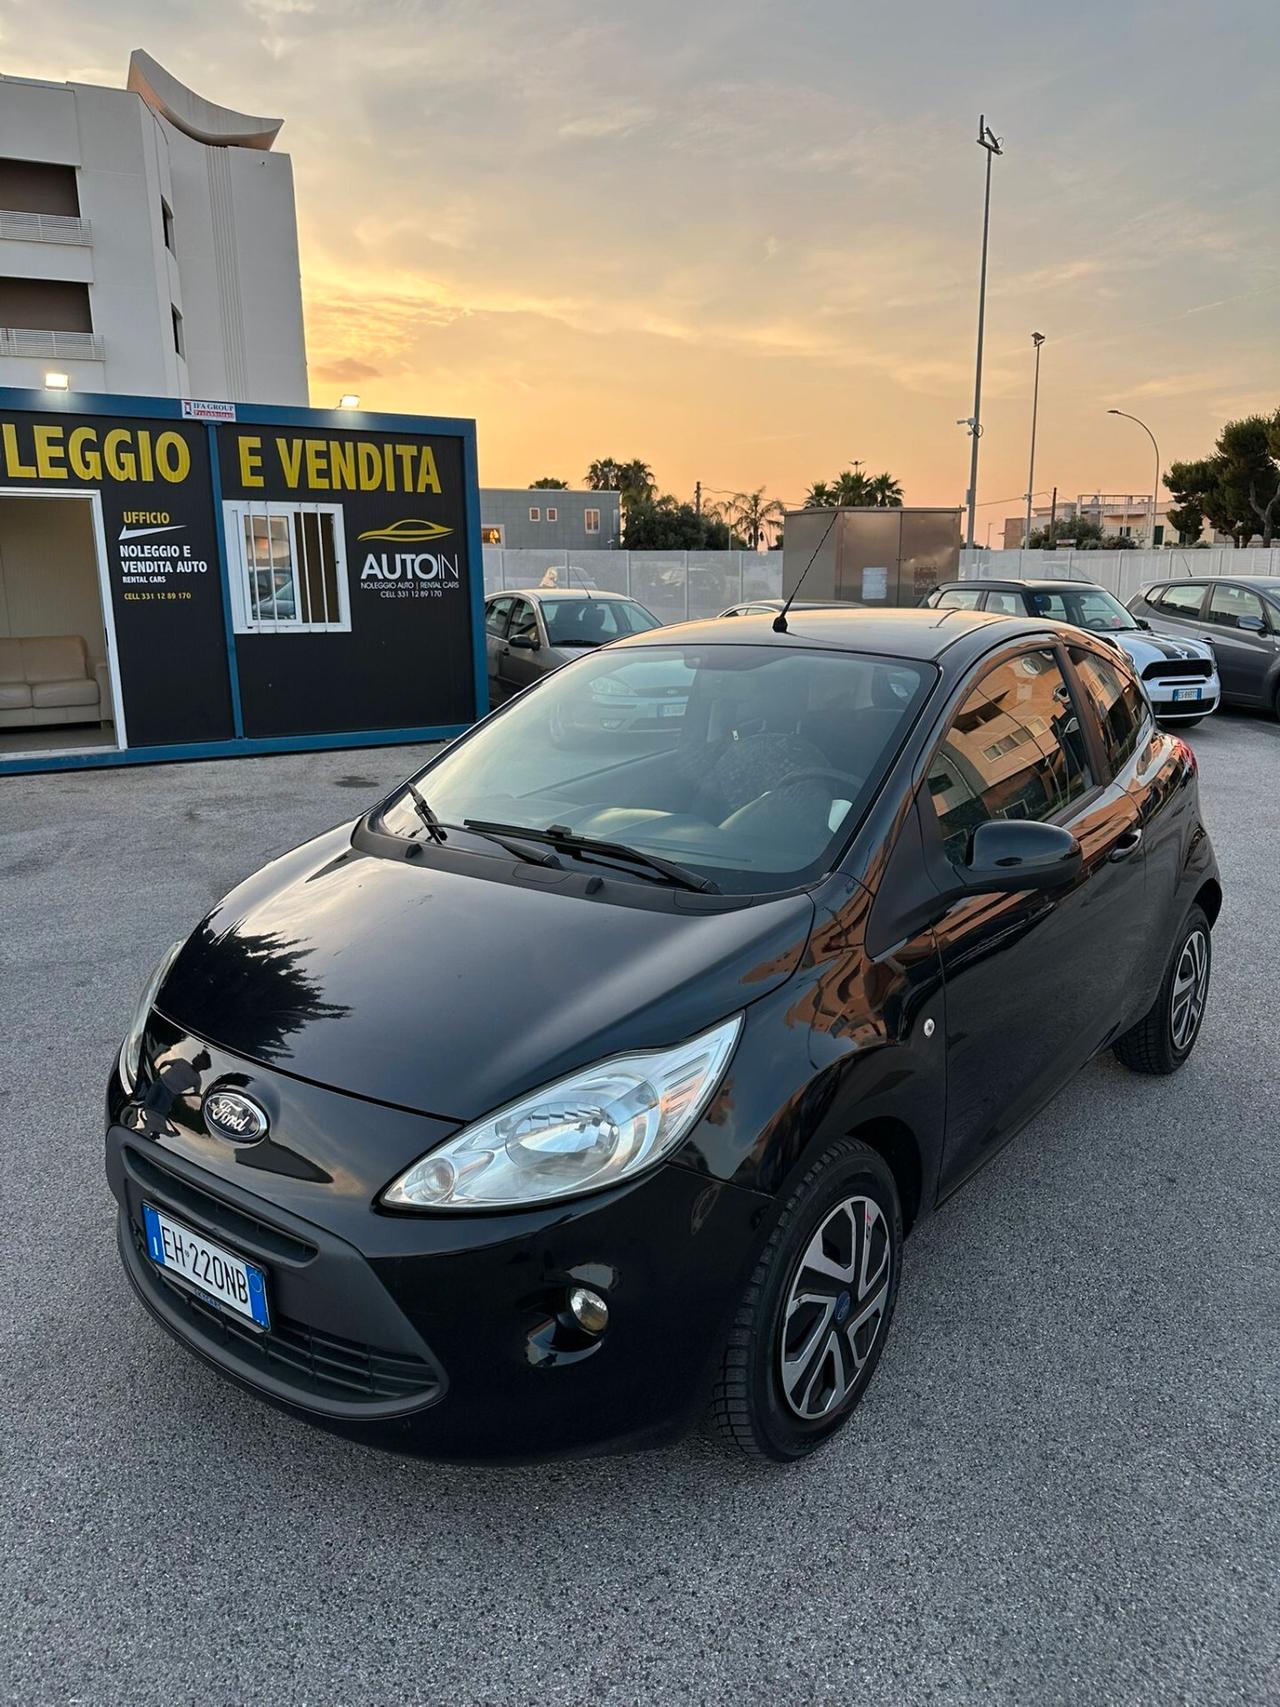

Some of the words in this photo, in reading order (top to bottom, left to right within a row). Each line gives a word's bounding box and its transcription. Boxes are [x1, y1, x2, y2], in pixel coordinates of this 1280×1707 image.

[2, 423, 191, 483] LEGGIO
[238, 436, 265, 487] E
[276, 438, 442, 494] VENDITA
[123, 511, 170, 524] UFFICIO
[119, 545, 180, 558] NOLEGGIO
[182, 545, 192, 558] E
[121, 561, 174, 574] VENDITA
[176, 561, 208, 574] AUTO
[122, 575, 148, 584] RENTAL
[149, 575, 167, 584] CARS
[360, 581, 396, 589] NOLEGGIO
[420, 581, 441, 589] RENTAL
[442, 581, 459, 589] CARS
[124, 592, 141, 600] CELL
[141, 592, 155, 600] 331
[157, 592, 166, 600] 12
[178, 592, 192, 600] 170
[380, 590, 396, 598] CELL
[397, 590, 409, 598] 331
[411, 590, 420, 598] 12
[420, 590, 429, 598] 89
[430, 590, 442, 598] 170
[212, 1099, 250, 1132] Ford
